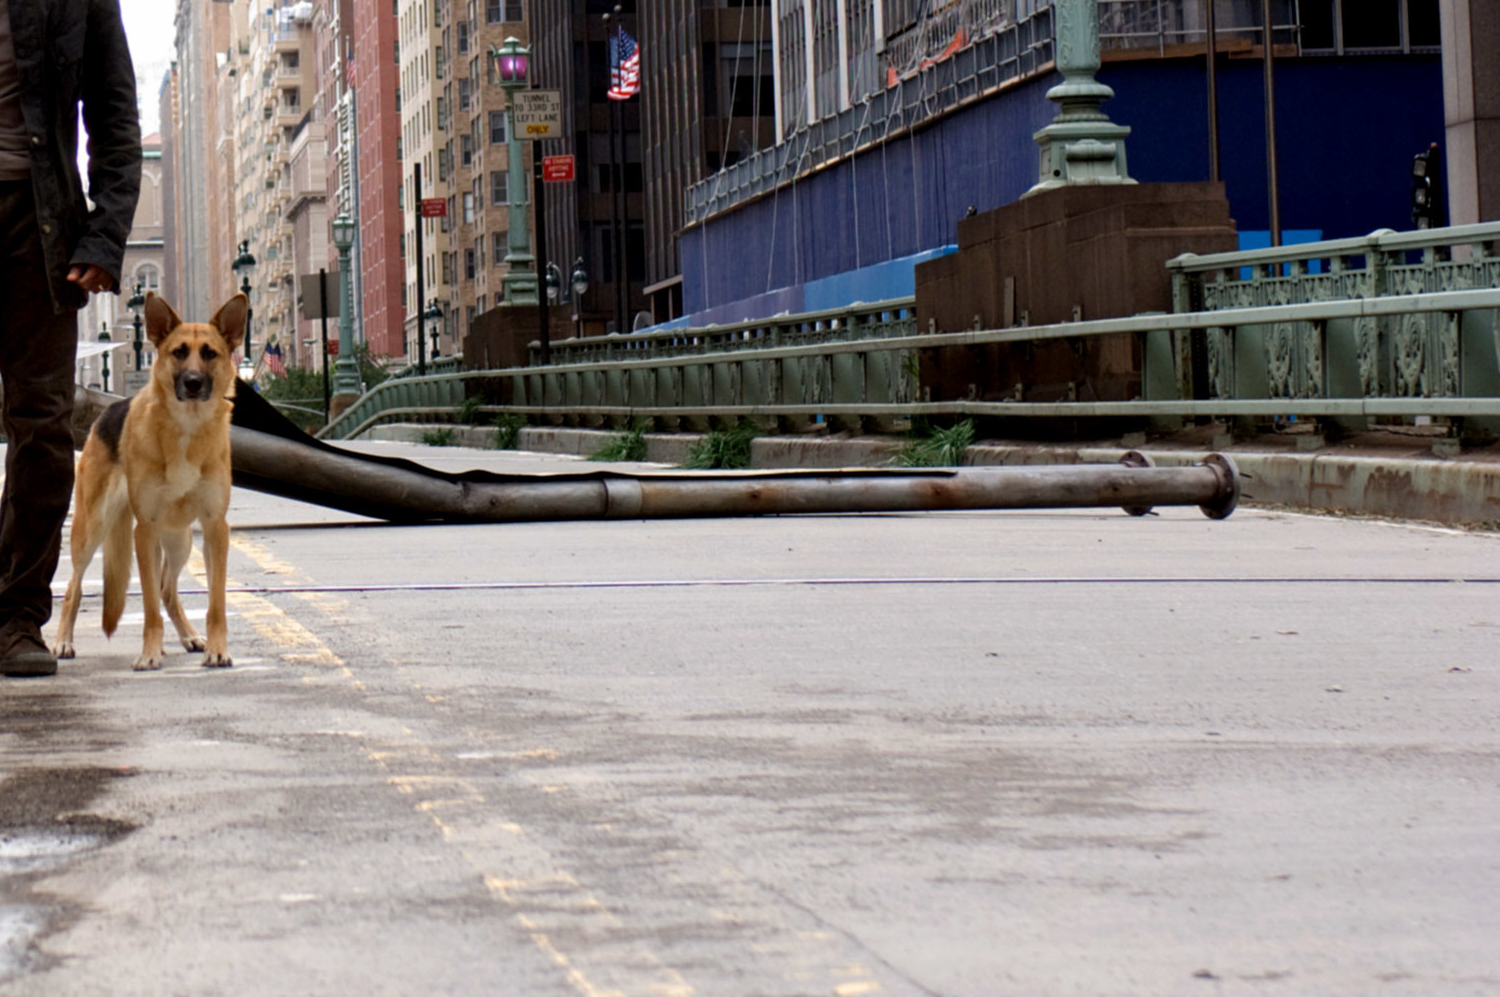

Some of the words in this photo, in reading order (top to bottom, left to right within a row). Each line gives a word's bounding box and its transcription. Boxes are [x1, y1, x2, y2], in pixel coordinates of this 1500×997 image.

[523, 94, 550, 103] TUNNEL
[515, 103, 524, 112] TO
[551, 102, 560, 111] ST
[516, 114, 534, 123] LEFT
[539, 113, 558, 122] LANE
[527, 125, 549, 134] ONLY
